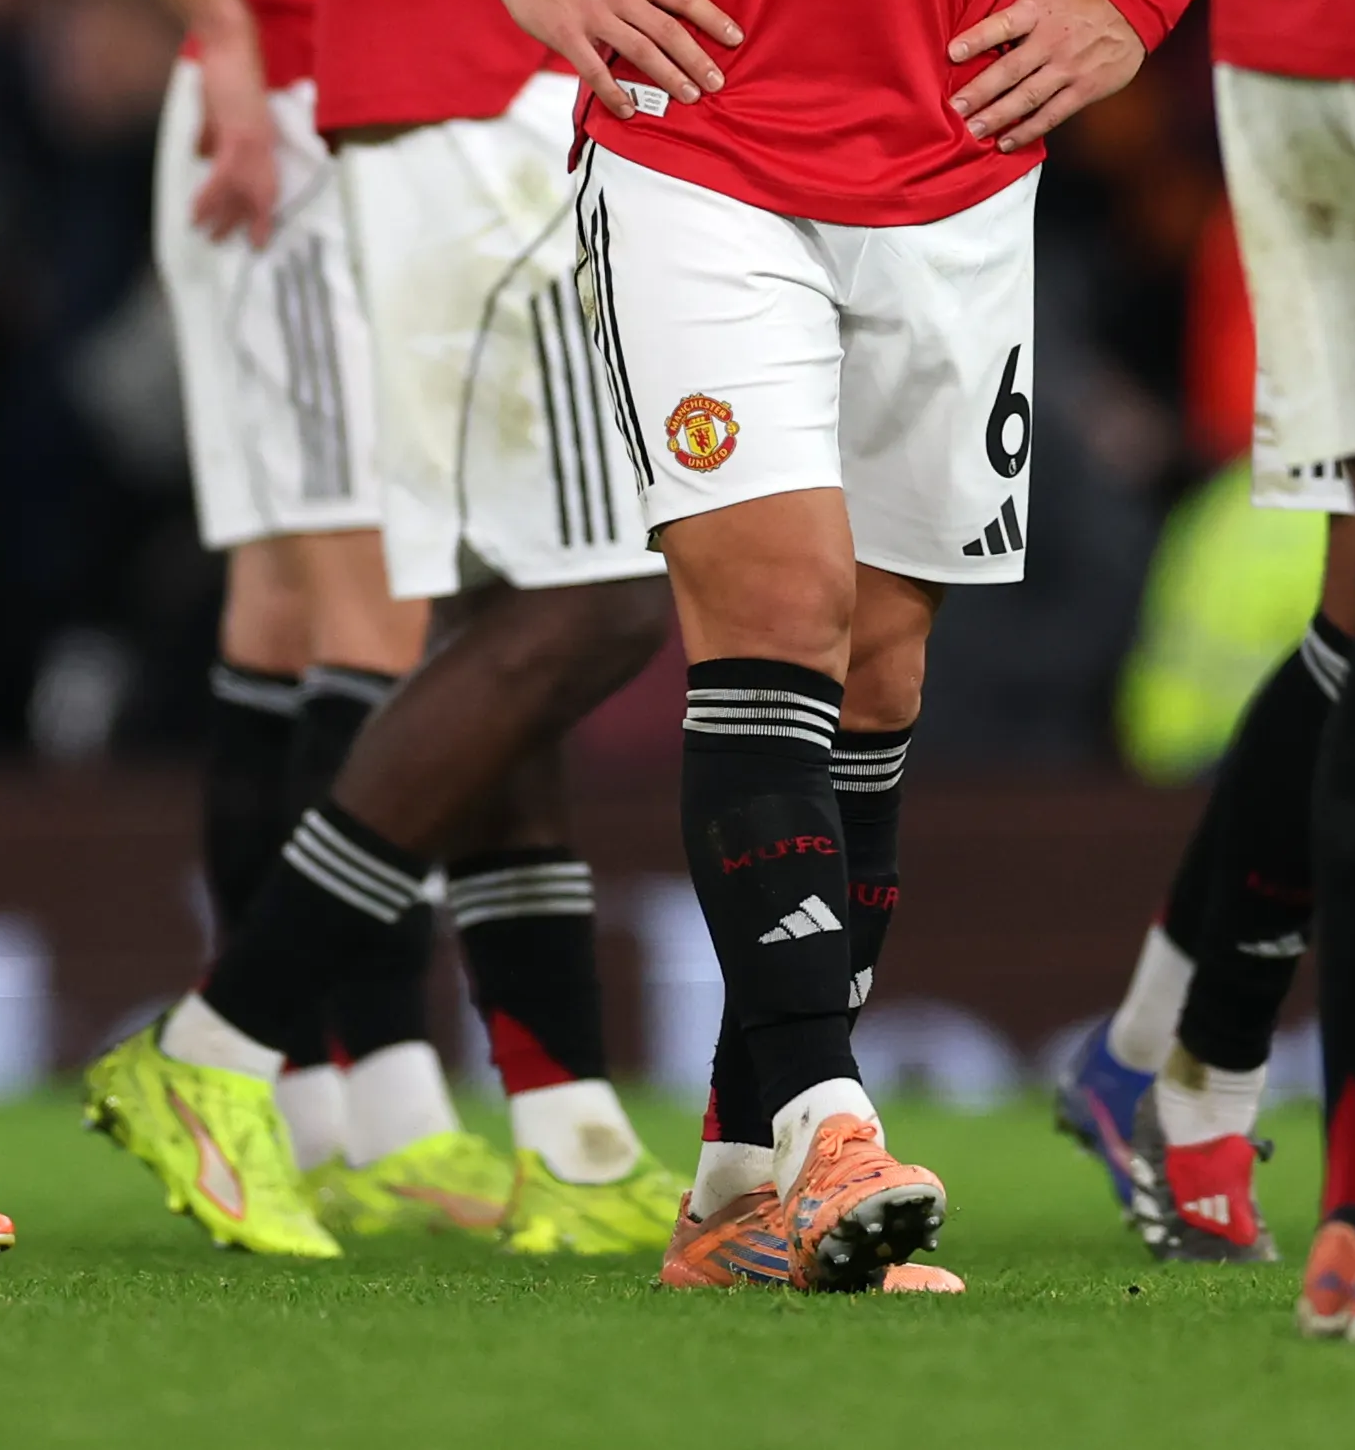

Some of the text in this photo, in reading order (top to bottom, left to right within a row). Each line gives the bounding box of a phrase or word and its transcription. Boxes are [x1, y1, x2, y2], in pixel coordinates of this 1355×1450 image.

[670, 399, 727, 431] MANCHESTER
[985, 343, 1031, 479] 6
[687, 448, 728, 467] UNITED
[722, 835, 840, 875] MUFC
